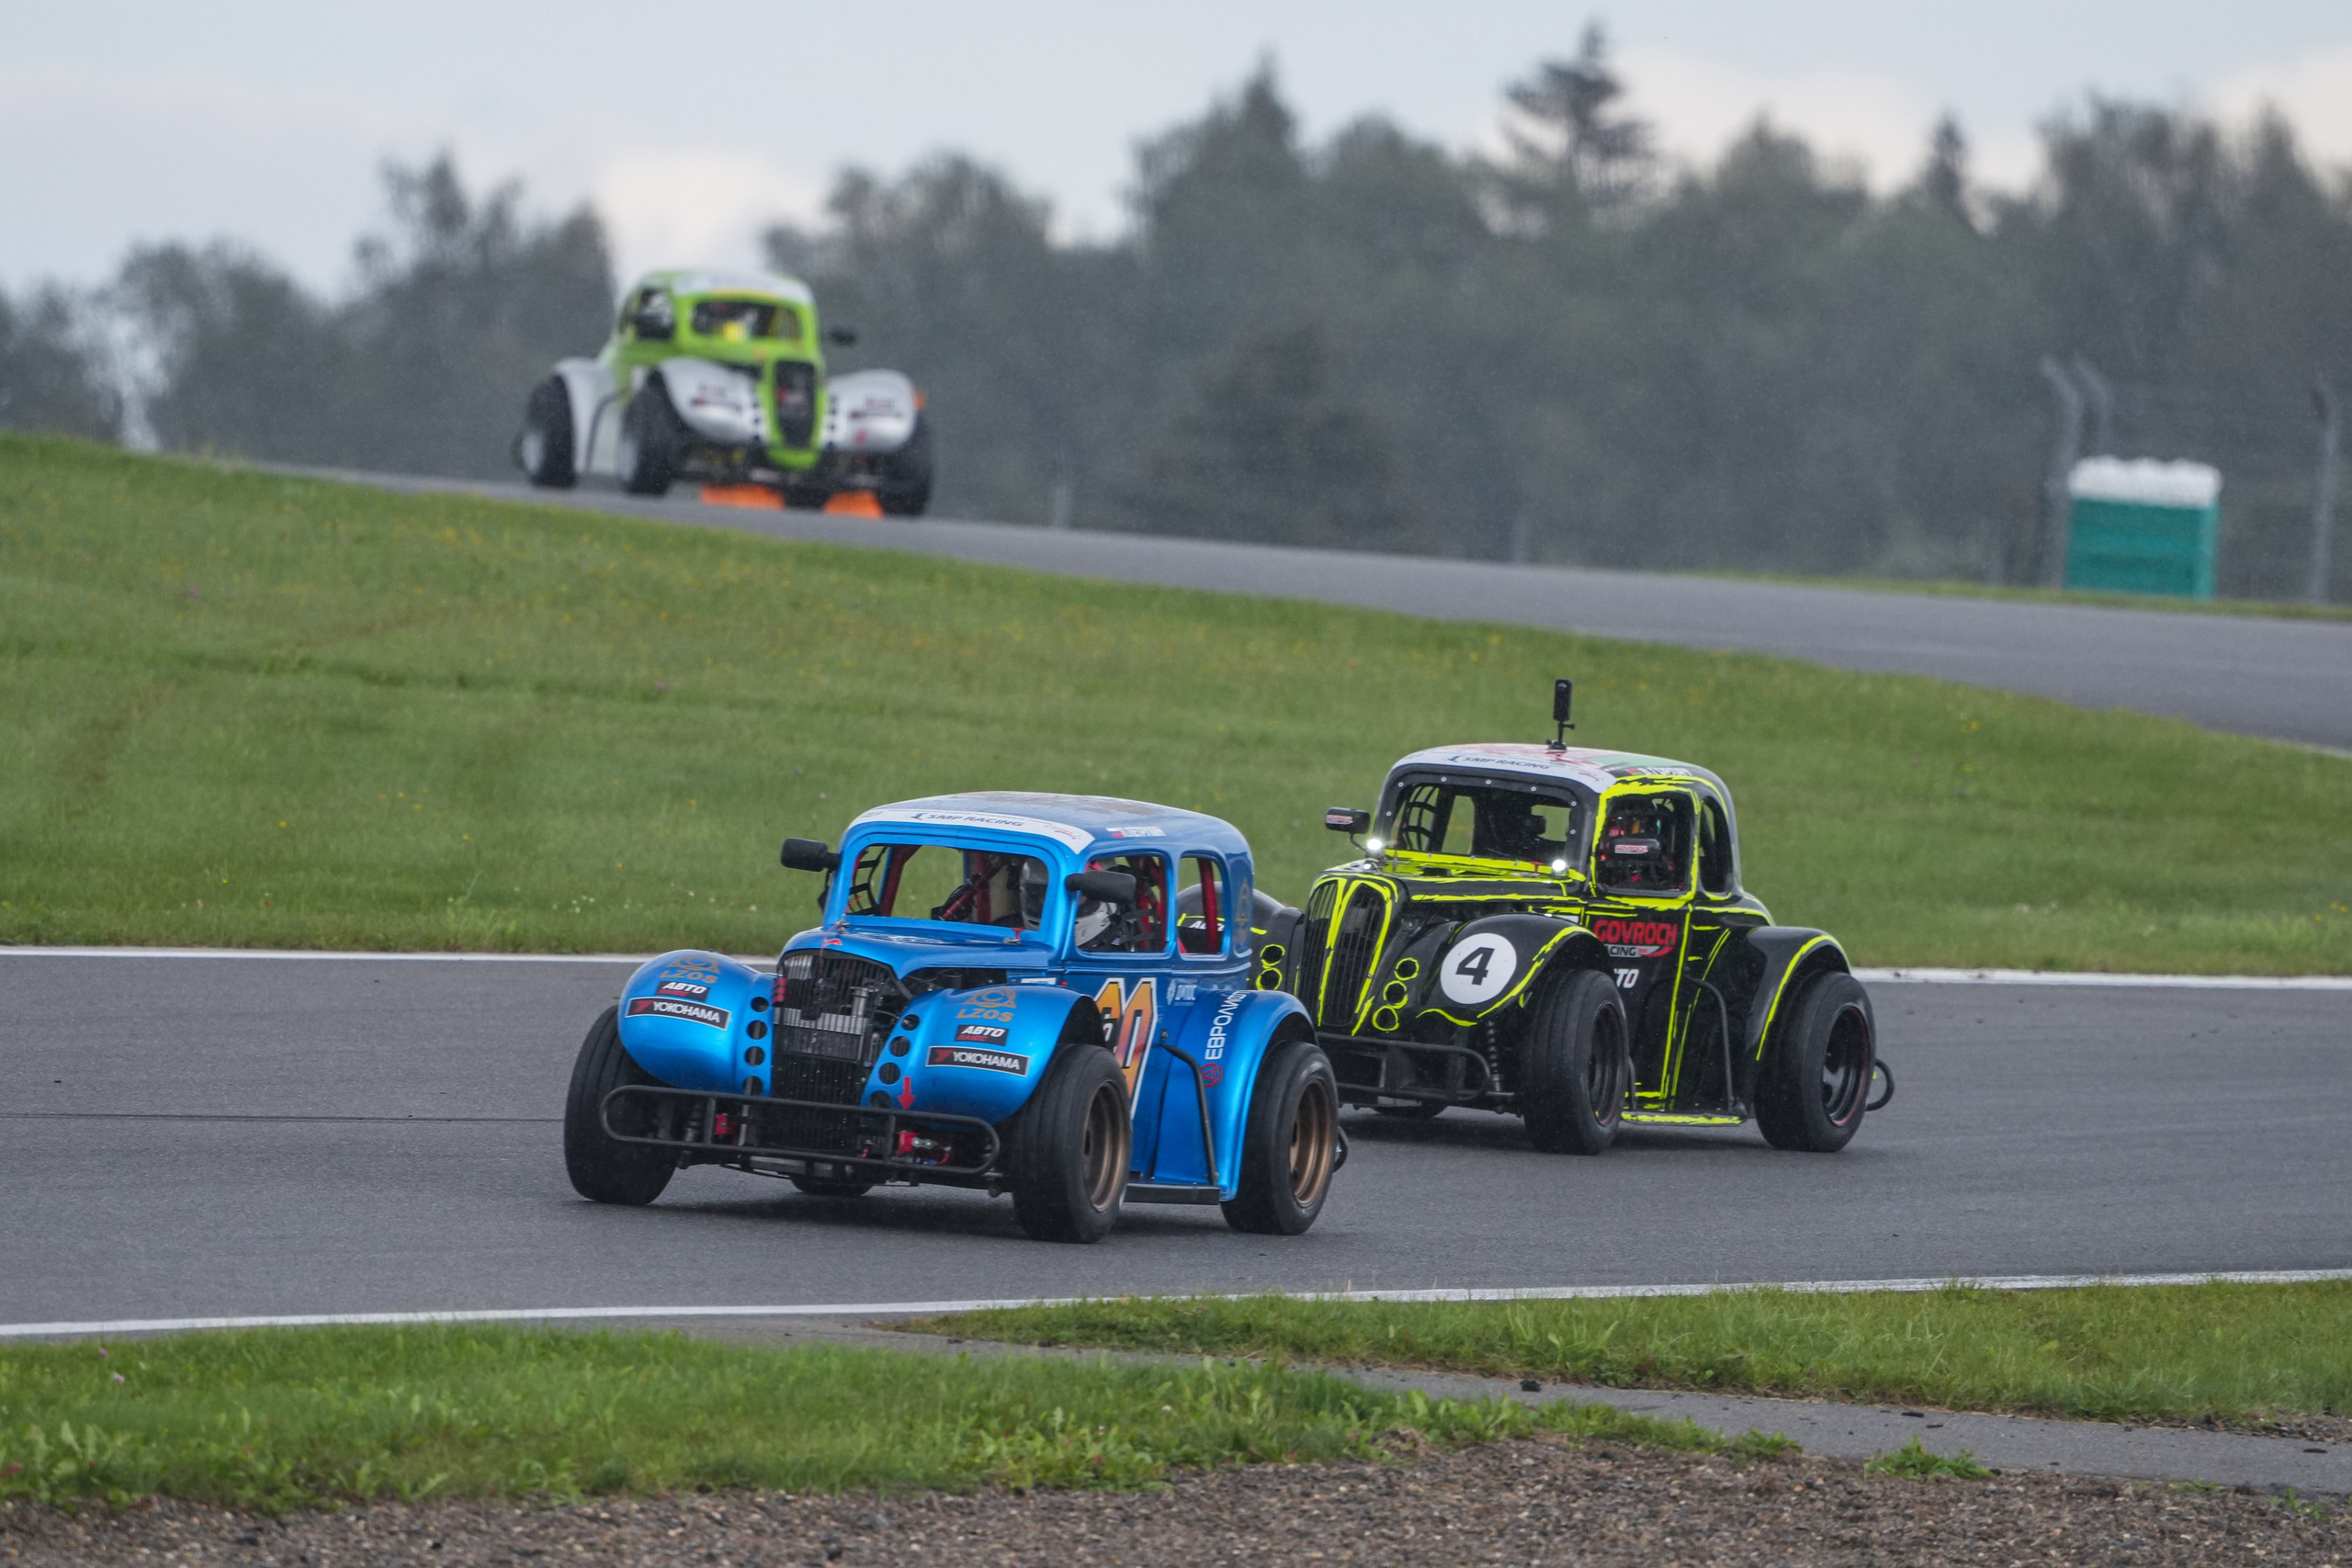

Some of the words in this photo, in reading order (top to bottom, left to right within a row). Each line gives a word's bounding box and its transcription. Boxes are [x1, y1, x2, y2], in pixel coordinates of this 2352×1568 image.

[1463, 756, 1496, 766] SMP
[1497, 759, 1551, 770] RACING
[964, 816, 1023, 827] RACING
[1594, 919, 1678, 945] GOVROCH
[1455, 946, 1496, 987] 4
[660, 970, 718, 984] LZOS
[662, 982, 707, 994] АВТО
[652, 1001, 720, 1023] YOKOHAMA
[956, 1009, 1014, 1022] LZOS
[961, 1025, 1006, 1038] АВТО
[953, 1051, 1020, 1070] YOKOHAMA
